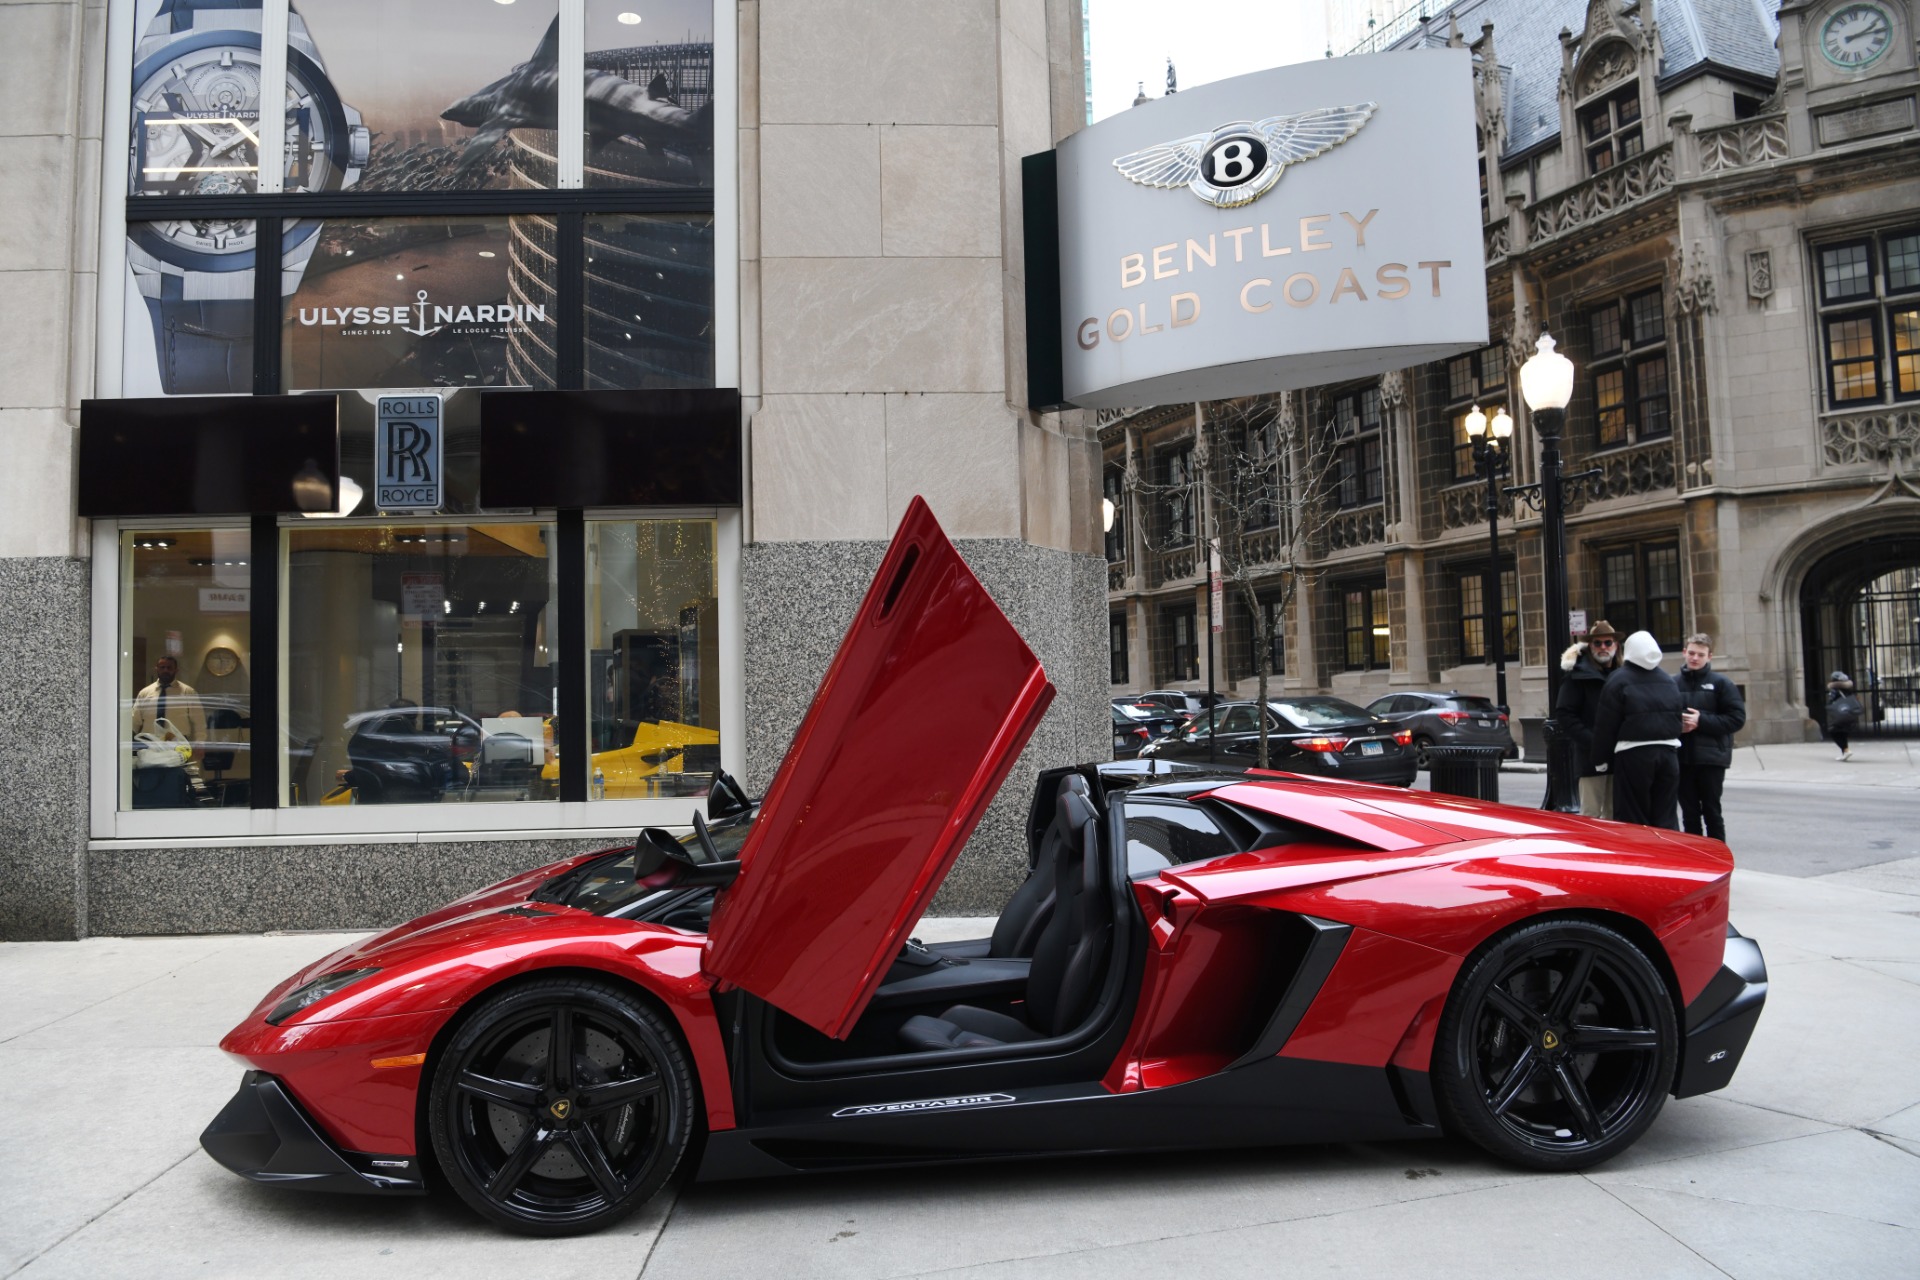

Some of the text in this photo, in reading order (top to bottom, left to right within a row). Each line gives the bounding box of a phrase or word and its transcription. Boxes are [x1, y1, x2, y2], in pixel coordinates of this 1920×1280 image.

[229, 111, 260, 119] NARDI
[1213, 139, 1255, 182] B
[1120, 208, 1379, 289] BENTLEY
[299, 304, 545, 326] ULYSSE NARDIN
[1076, 260, 1452, 352] GOLD COAST
[382, 401, 435, 415] ROLLS
[381, 488, 434, 502] ROYCE
[855, 1095, 992, 1114] AVENTADOR
